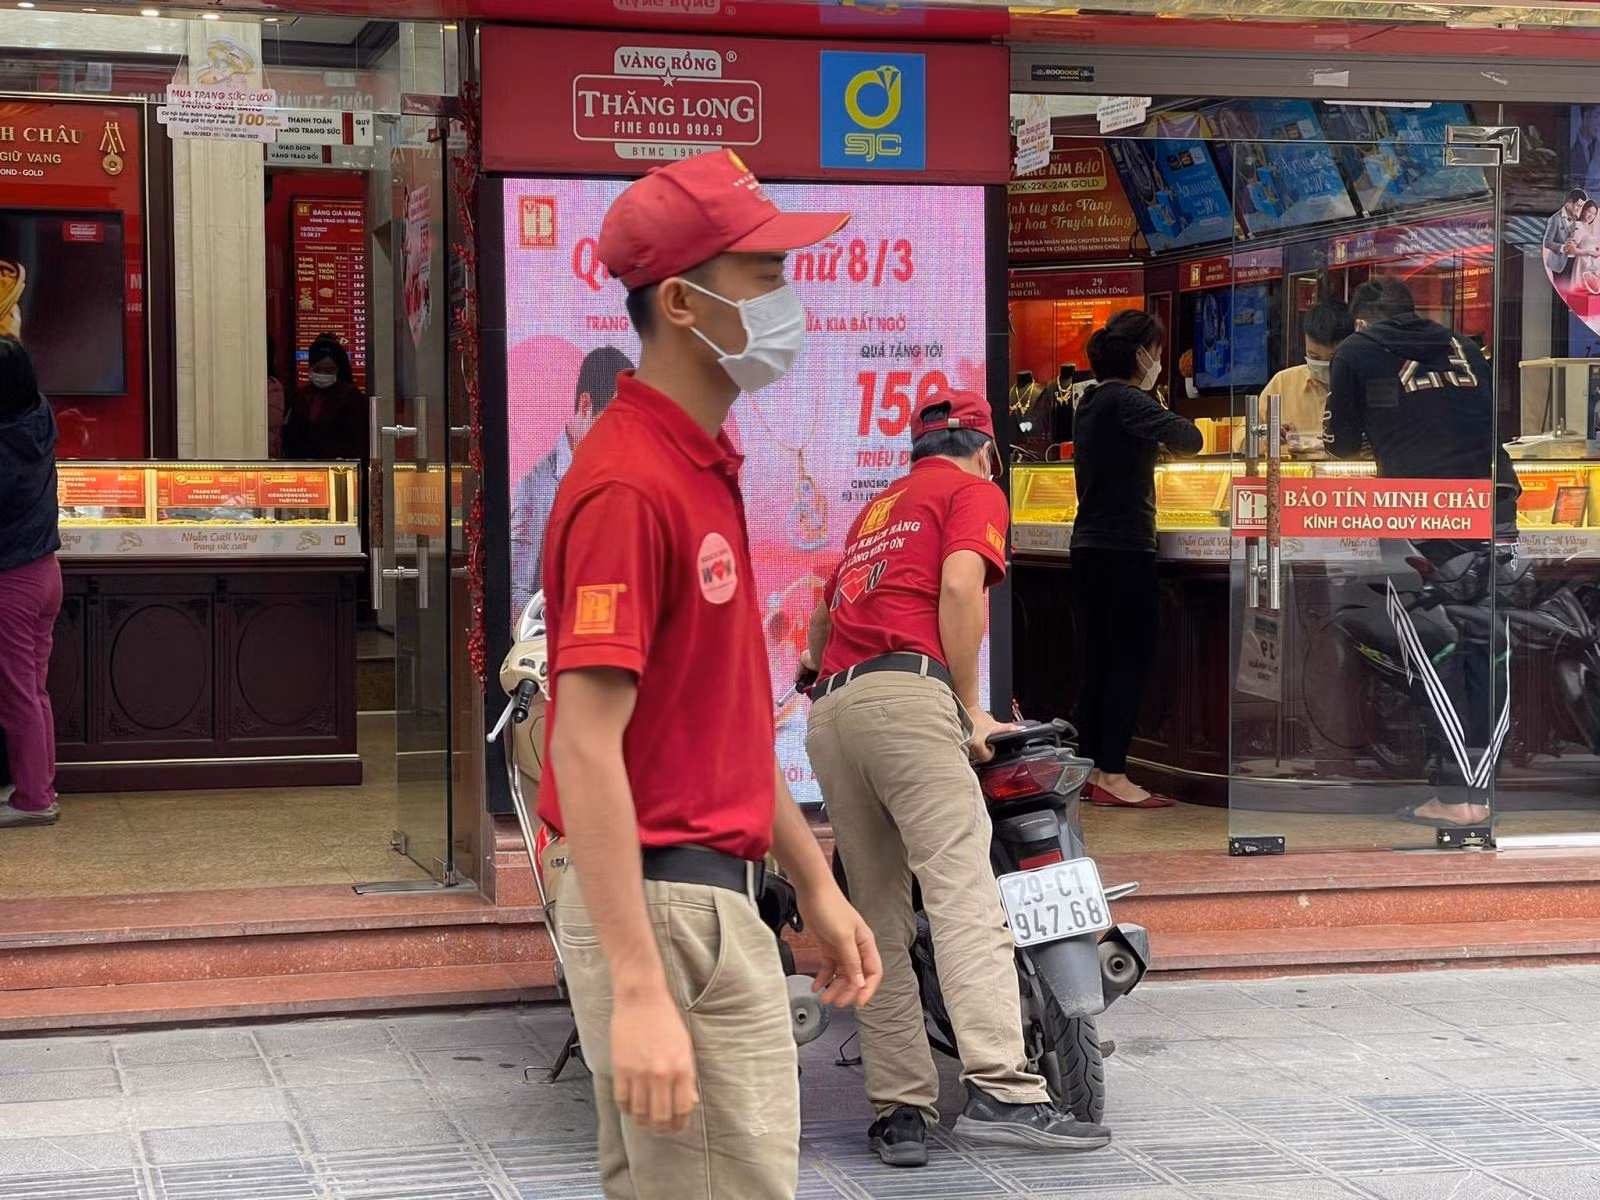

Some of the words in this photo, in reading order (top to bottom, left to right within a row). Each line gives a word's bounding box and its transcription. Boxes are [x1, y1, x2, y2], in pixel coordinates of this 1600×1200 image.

[620, 51, 666, 69] VÀNG
[671, 51, 717, 71] RỒNG
[171, 89, 192, 98] MUA
[194, 90, 225, 99] TRANG
[578, 90, 675, 118] THĂNG
[682, 96, 755, 122] LONG
[238, 112, 264, 126] 100
[313, 115, 333, 124] TOÁN
[23, 124, 83, 144] CHÂU
[327, 126, 341, 135] SỨC
[360, 127, 366, 136] 1
[614, 121, 642, 134] FINE
[649, 122, 680, 135] GOLD
[686, 123, 723, 136] 999.9
[632, 147, 665, 157] BTMC
[844, 132, 902, 162] SJC
[22, 169, 44, 177] GOLD
[1049, 162, 1072, 176] KIM
[1071, 179, 1099, 188] GOLD
[1025, 218, 1048, 230] hoa
[793, 242, 844, 282] nữ
[847, 238, 914, 287] 8/3
[1092, 277, 1103, 286] 29
[1008, 289, 1023, 297] INH
[1067, 287, 1085, 296] TRẦN
[1086, 286, 1108, 295] NHÂN
[1109, 286, 1128, 294] TÔNG
[585, 315, 630, 332] TRANG
[827, 316, 848, 332] KIA
[1284, 486, 1328, 508] BẢO
[1331, 486, 1368, 508] TÍN
[1372, 491, 1428, 509] MINH
[1433, 488, 1492, 510] CHÂU
[888, 520, 921, 536] HÀNG
[1303, 513, 1338, 529] KÍNH
[1341, 513, 1383, 530] CHÀO
[1386, 513, 1416, 530] QUÝ
[1420, 513, 1471, 530] KHÁCH
[1014, 897, 1103, 940] 947.68
